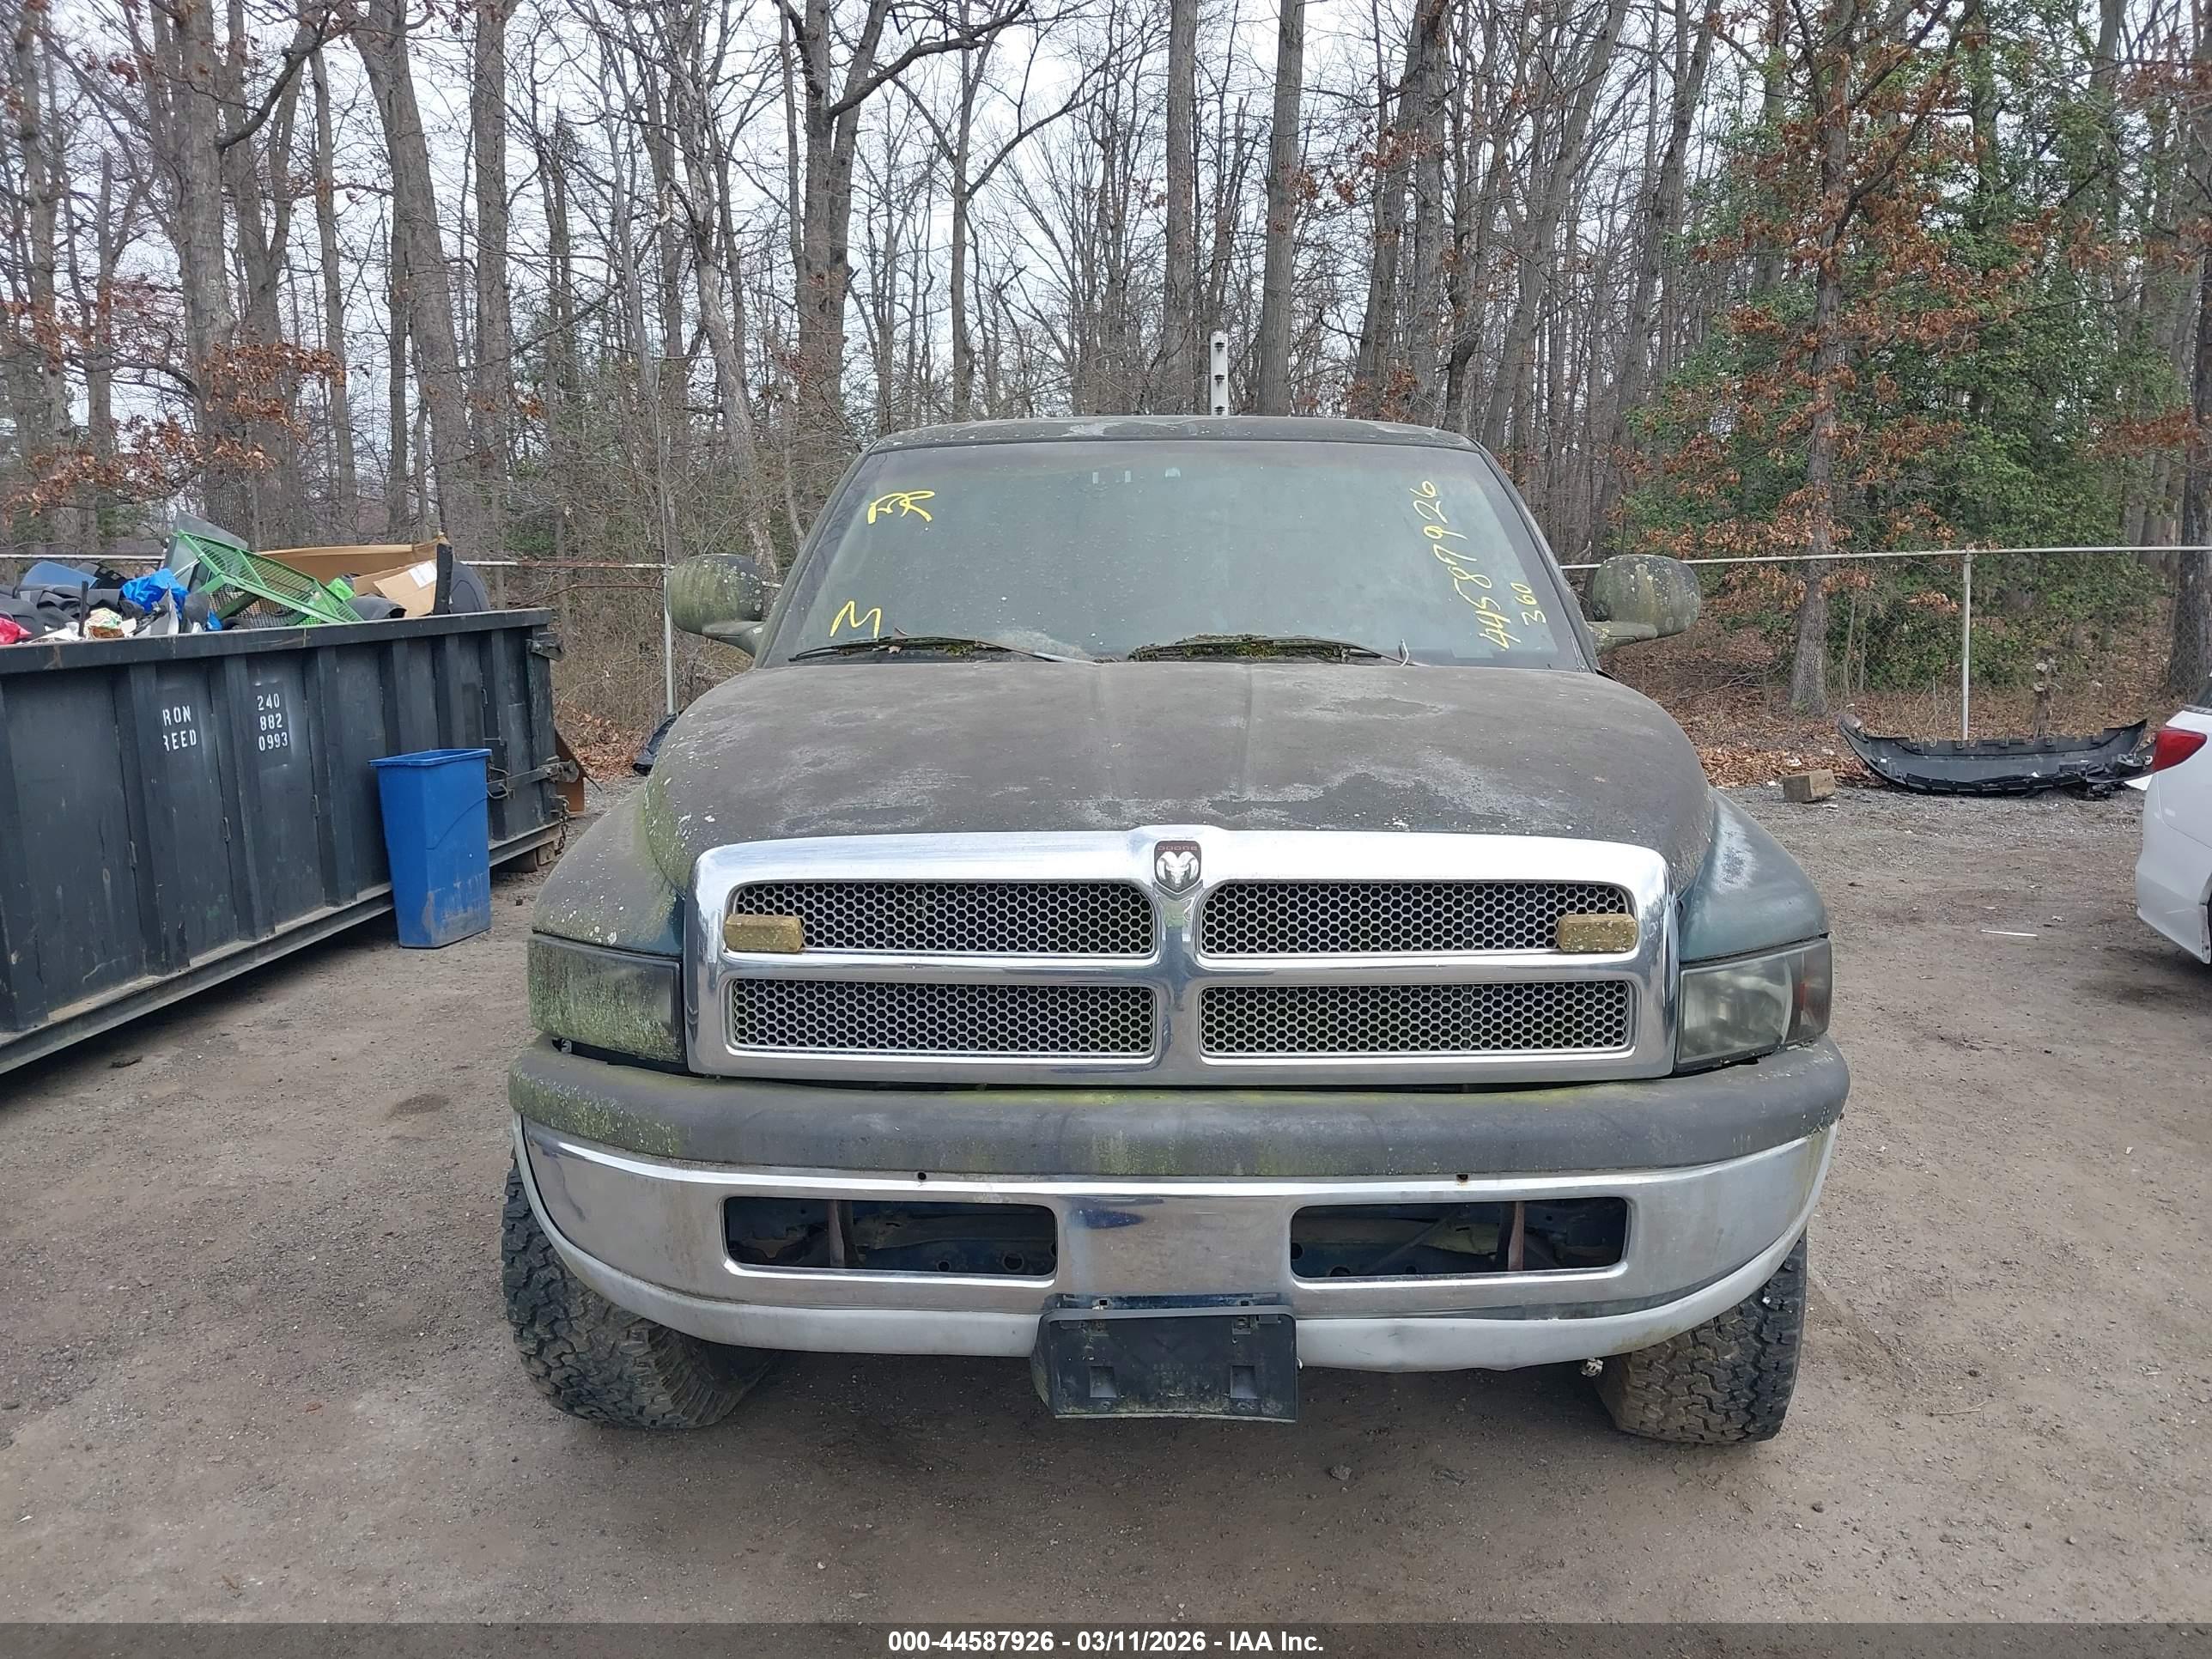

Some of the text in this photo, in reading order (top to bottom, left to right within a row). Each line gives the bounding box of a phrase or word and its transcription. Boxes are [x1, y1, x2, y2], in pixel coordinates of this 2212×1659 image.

[257, 693, 281, 711] 240
[259, 713, 283, 732] 882
[258, 732, 289, 751] 0993
